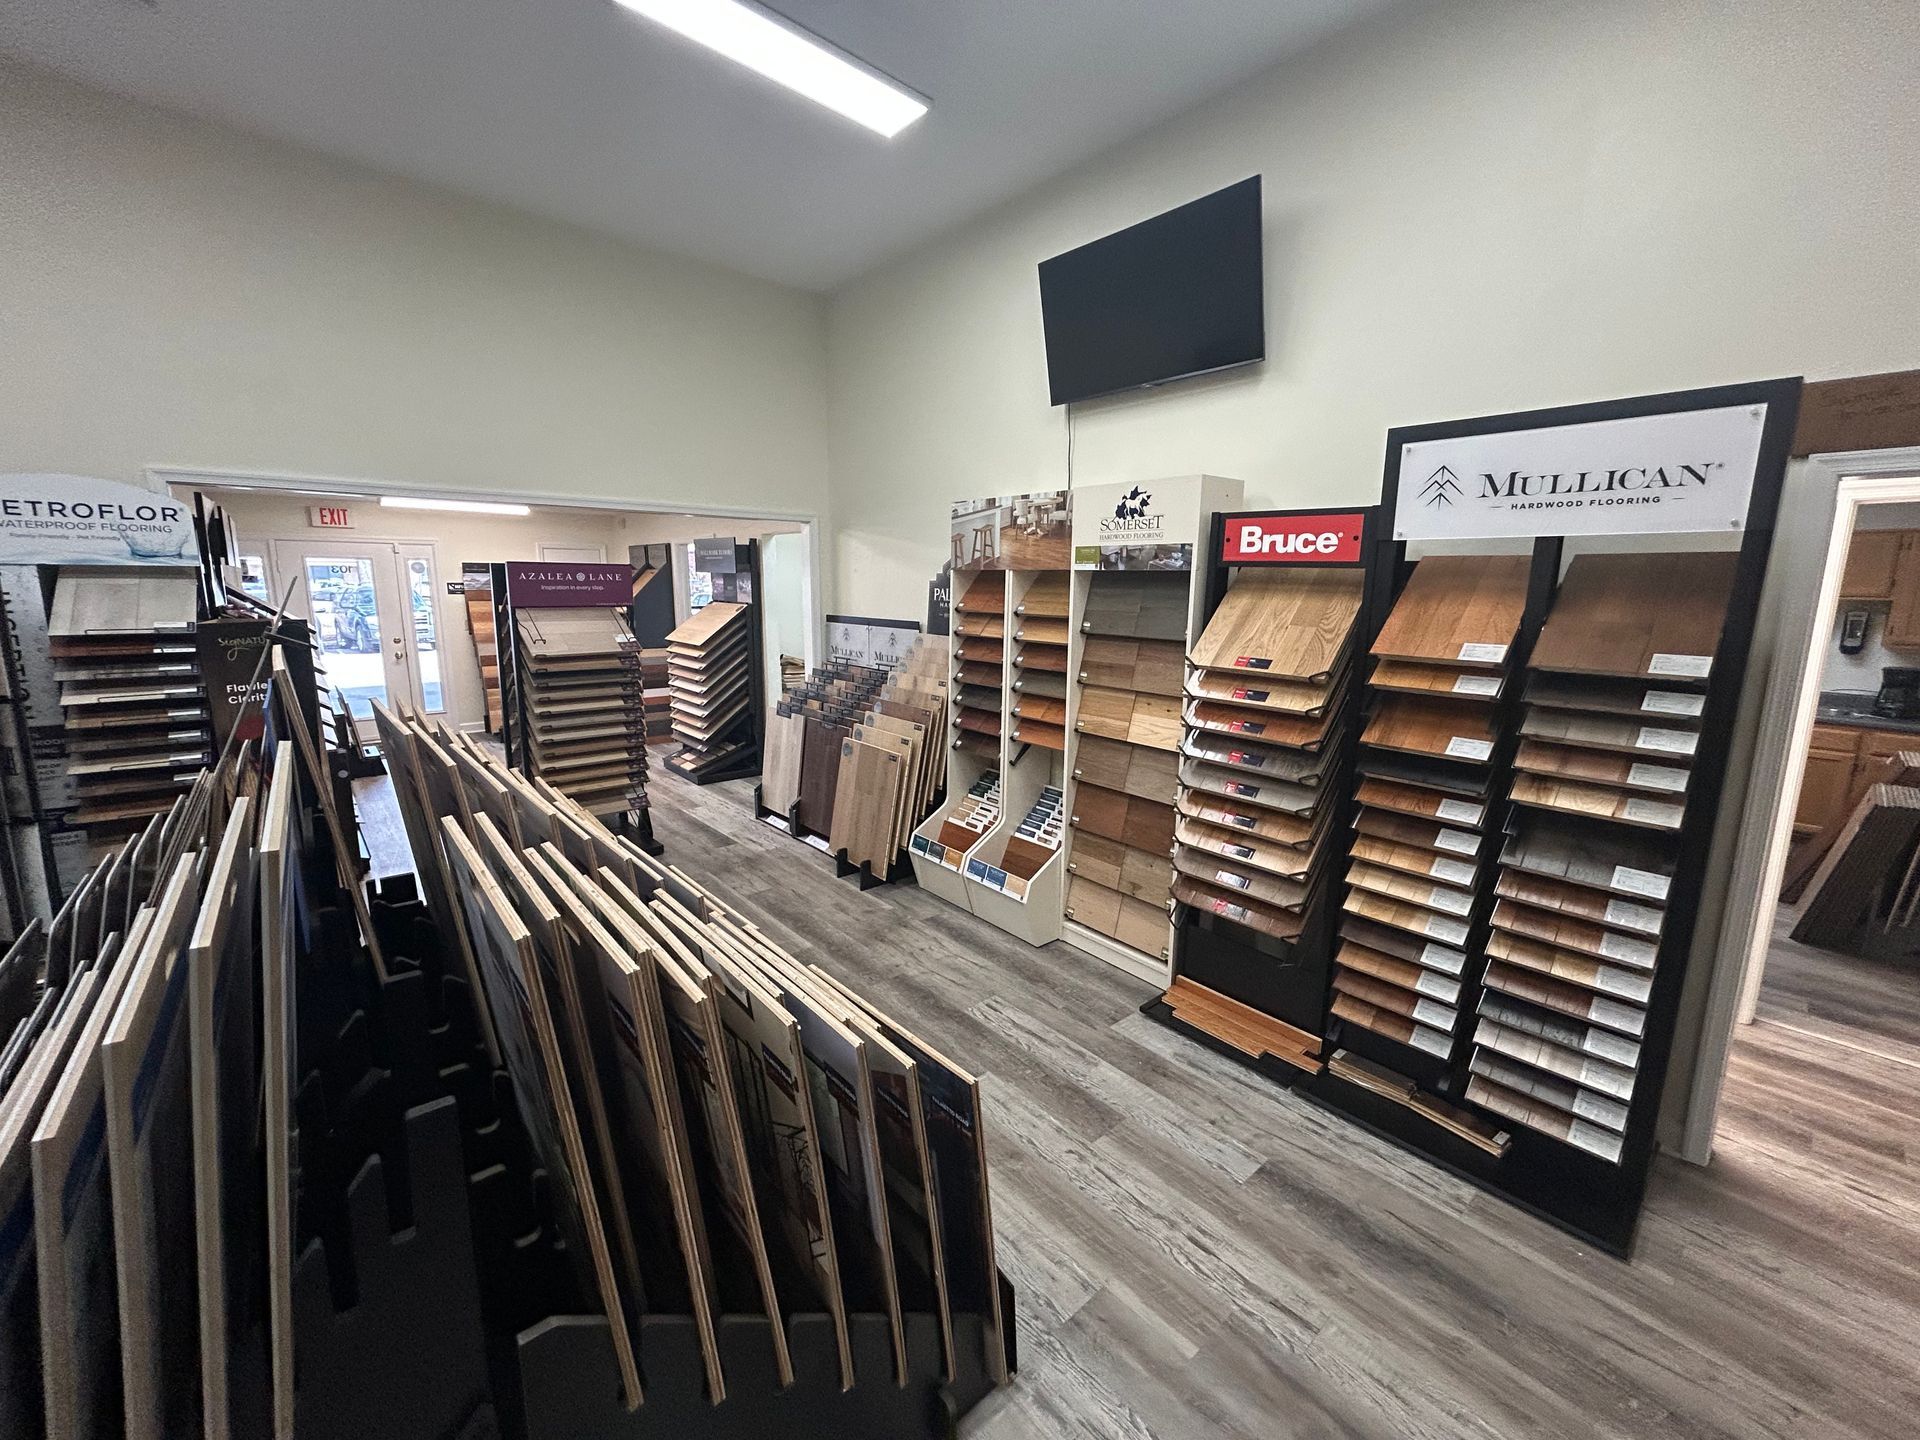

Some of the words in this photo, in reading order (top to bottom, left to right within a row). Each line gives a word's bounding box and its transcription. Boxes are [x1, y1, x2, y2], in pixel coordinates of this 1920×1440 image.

[1475, 463, 1714, 499] MULLICAN
[1511, 500, 1584, 510] HARDWOOD
[1589, 496, 1662, 507] FLOORING
[1, 499, 180, 522] ETROFLOR
[319, 507, 348, 525] EXIT
[102, 522, 173, 533] FLOORING
[1100, 514, 1164, 531] SOMERSET
[1100, 532, 1131, 541] HARDWOOD
[1133, 531, 1163, 540] FLOORING
[1240, 525, 1339, 554] Bruce
[519, 572, 573, 581] AZALEA
[589, 573, 622, 581] LANE
[934, 587, 950, 601] PAL
[226, 682, 268, 693] Flawle
[228, 693, 267, 704] Clarit
